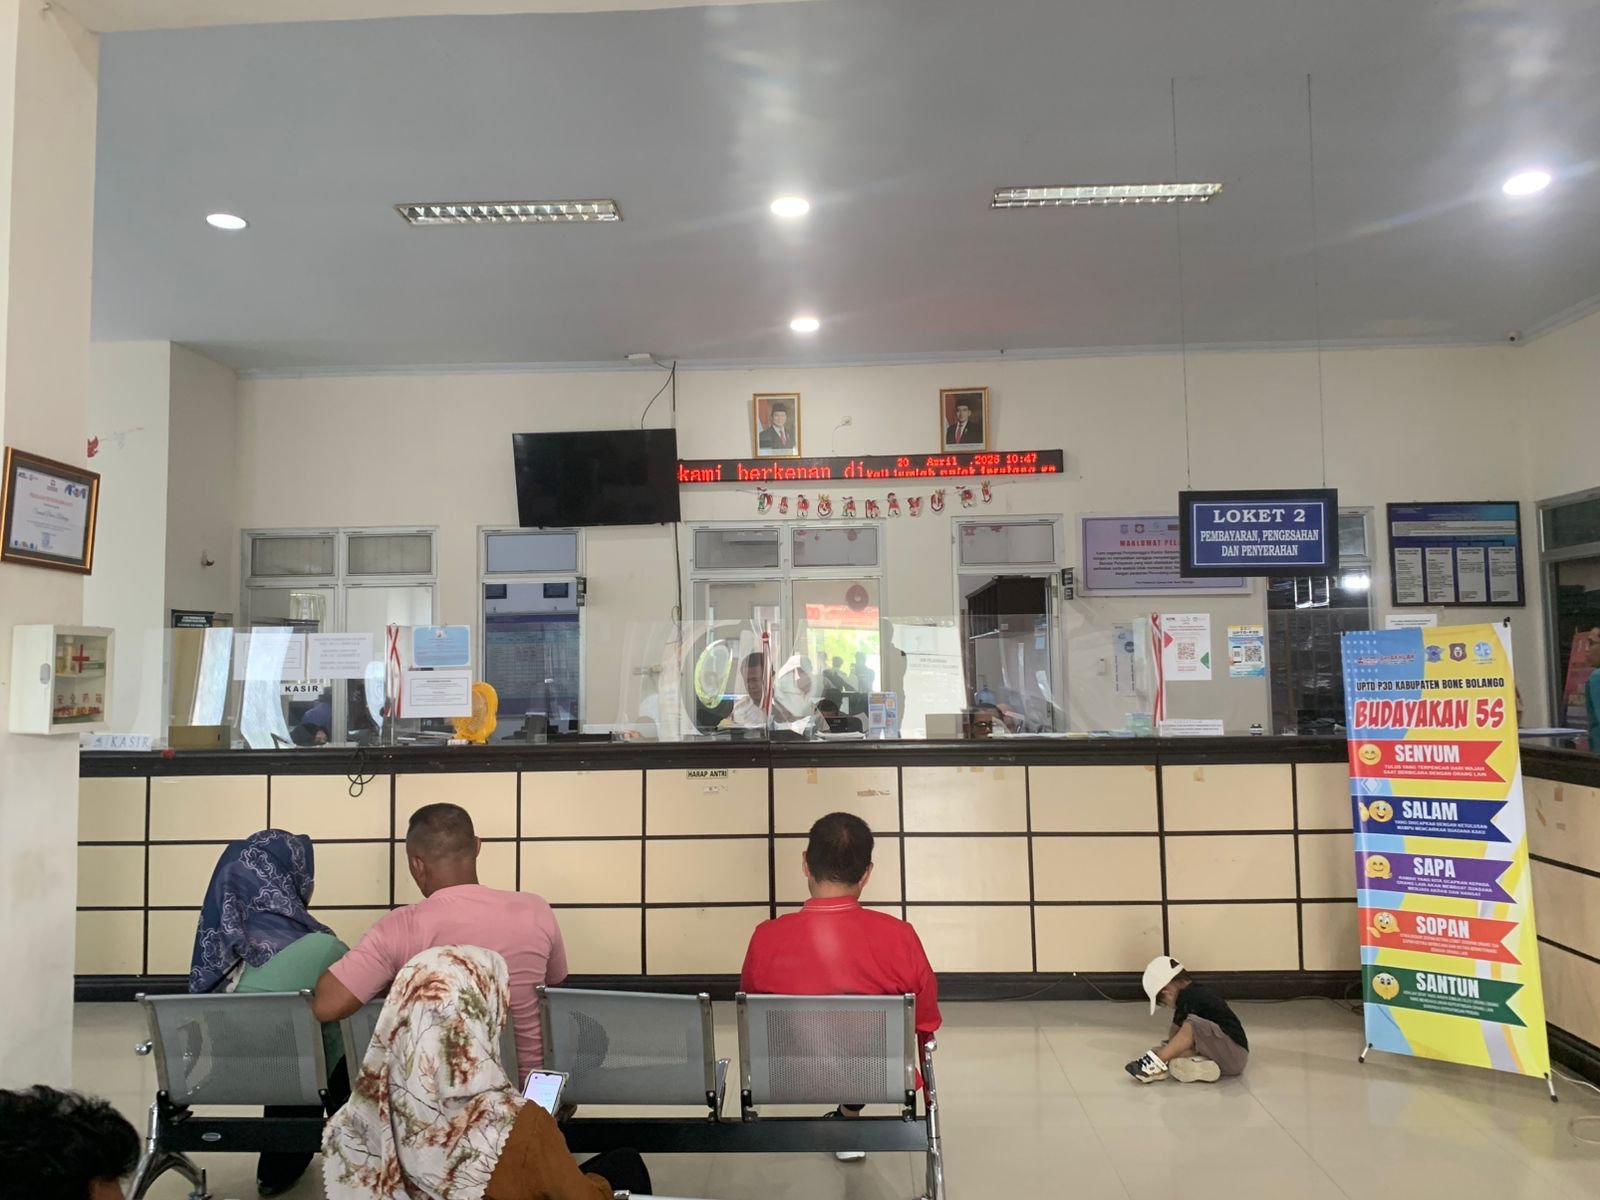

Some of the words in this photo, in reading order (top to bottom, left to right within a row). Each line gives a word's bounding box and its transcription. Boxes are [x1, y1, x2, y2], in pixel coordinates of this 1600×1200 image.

[1006, 452, 1037, 464] 10:47
[679, 463, 722, 482] kami
[1213, 509, 1286, 523] LOKET
[1293, 508, 1306, 522] 2
[1119, 539, 1161, 547] MAKLUMAT
[1200, 530, 1261, 543] PEMBAYARAN,
[1262, 529, 1319, 541] PENGESAHAN
[1221, 545, 1240, 557] DAN
[1241, 545, 1298, 556] PENYERAHAN
[1356, 681, 1376, 691] UPTD
[1378, 681, 1393, 690] P3D
[1395, 680, 1440, 690] KABUPATEN
[1442, 679, 1463, 689] BONE
[1465, 678, 1505, 689] BOLANGO
[1355, 700, 1469, 729] BUDAYAKAN
[1475, 698, 1505, 729] 5S
[110, 735, 150, 749] KASIR
[1394, 744, 1461, 764] SENYUM
[1402, 800, 1459, 821] SALAM
[1413, 857, 1456, 878] SAPA
[1415, 916, 1470, 939] SOPAN
[1415, 973, 1480, 998] SANTUN
